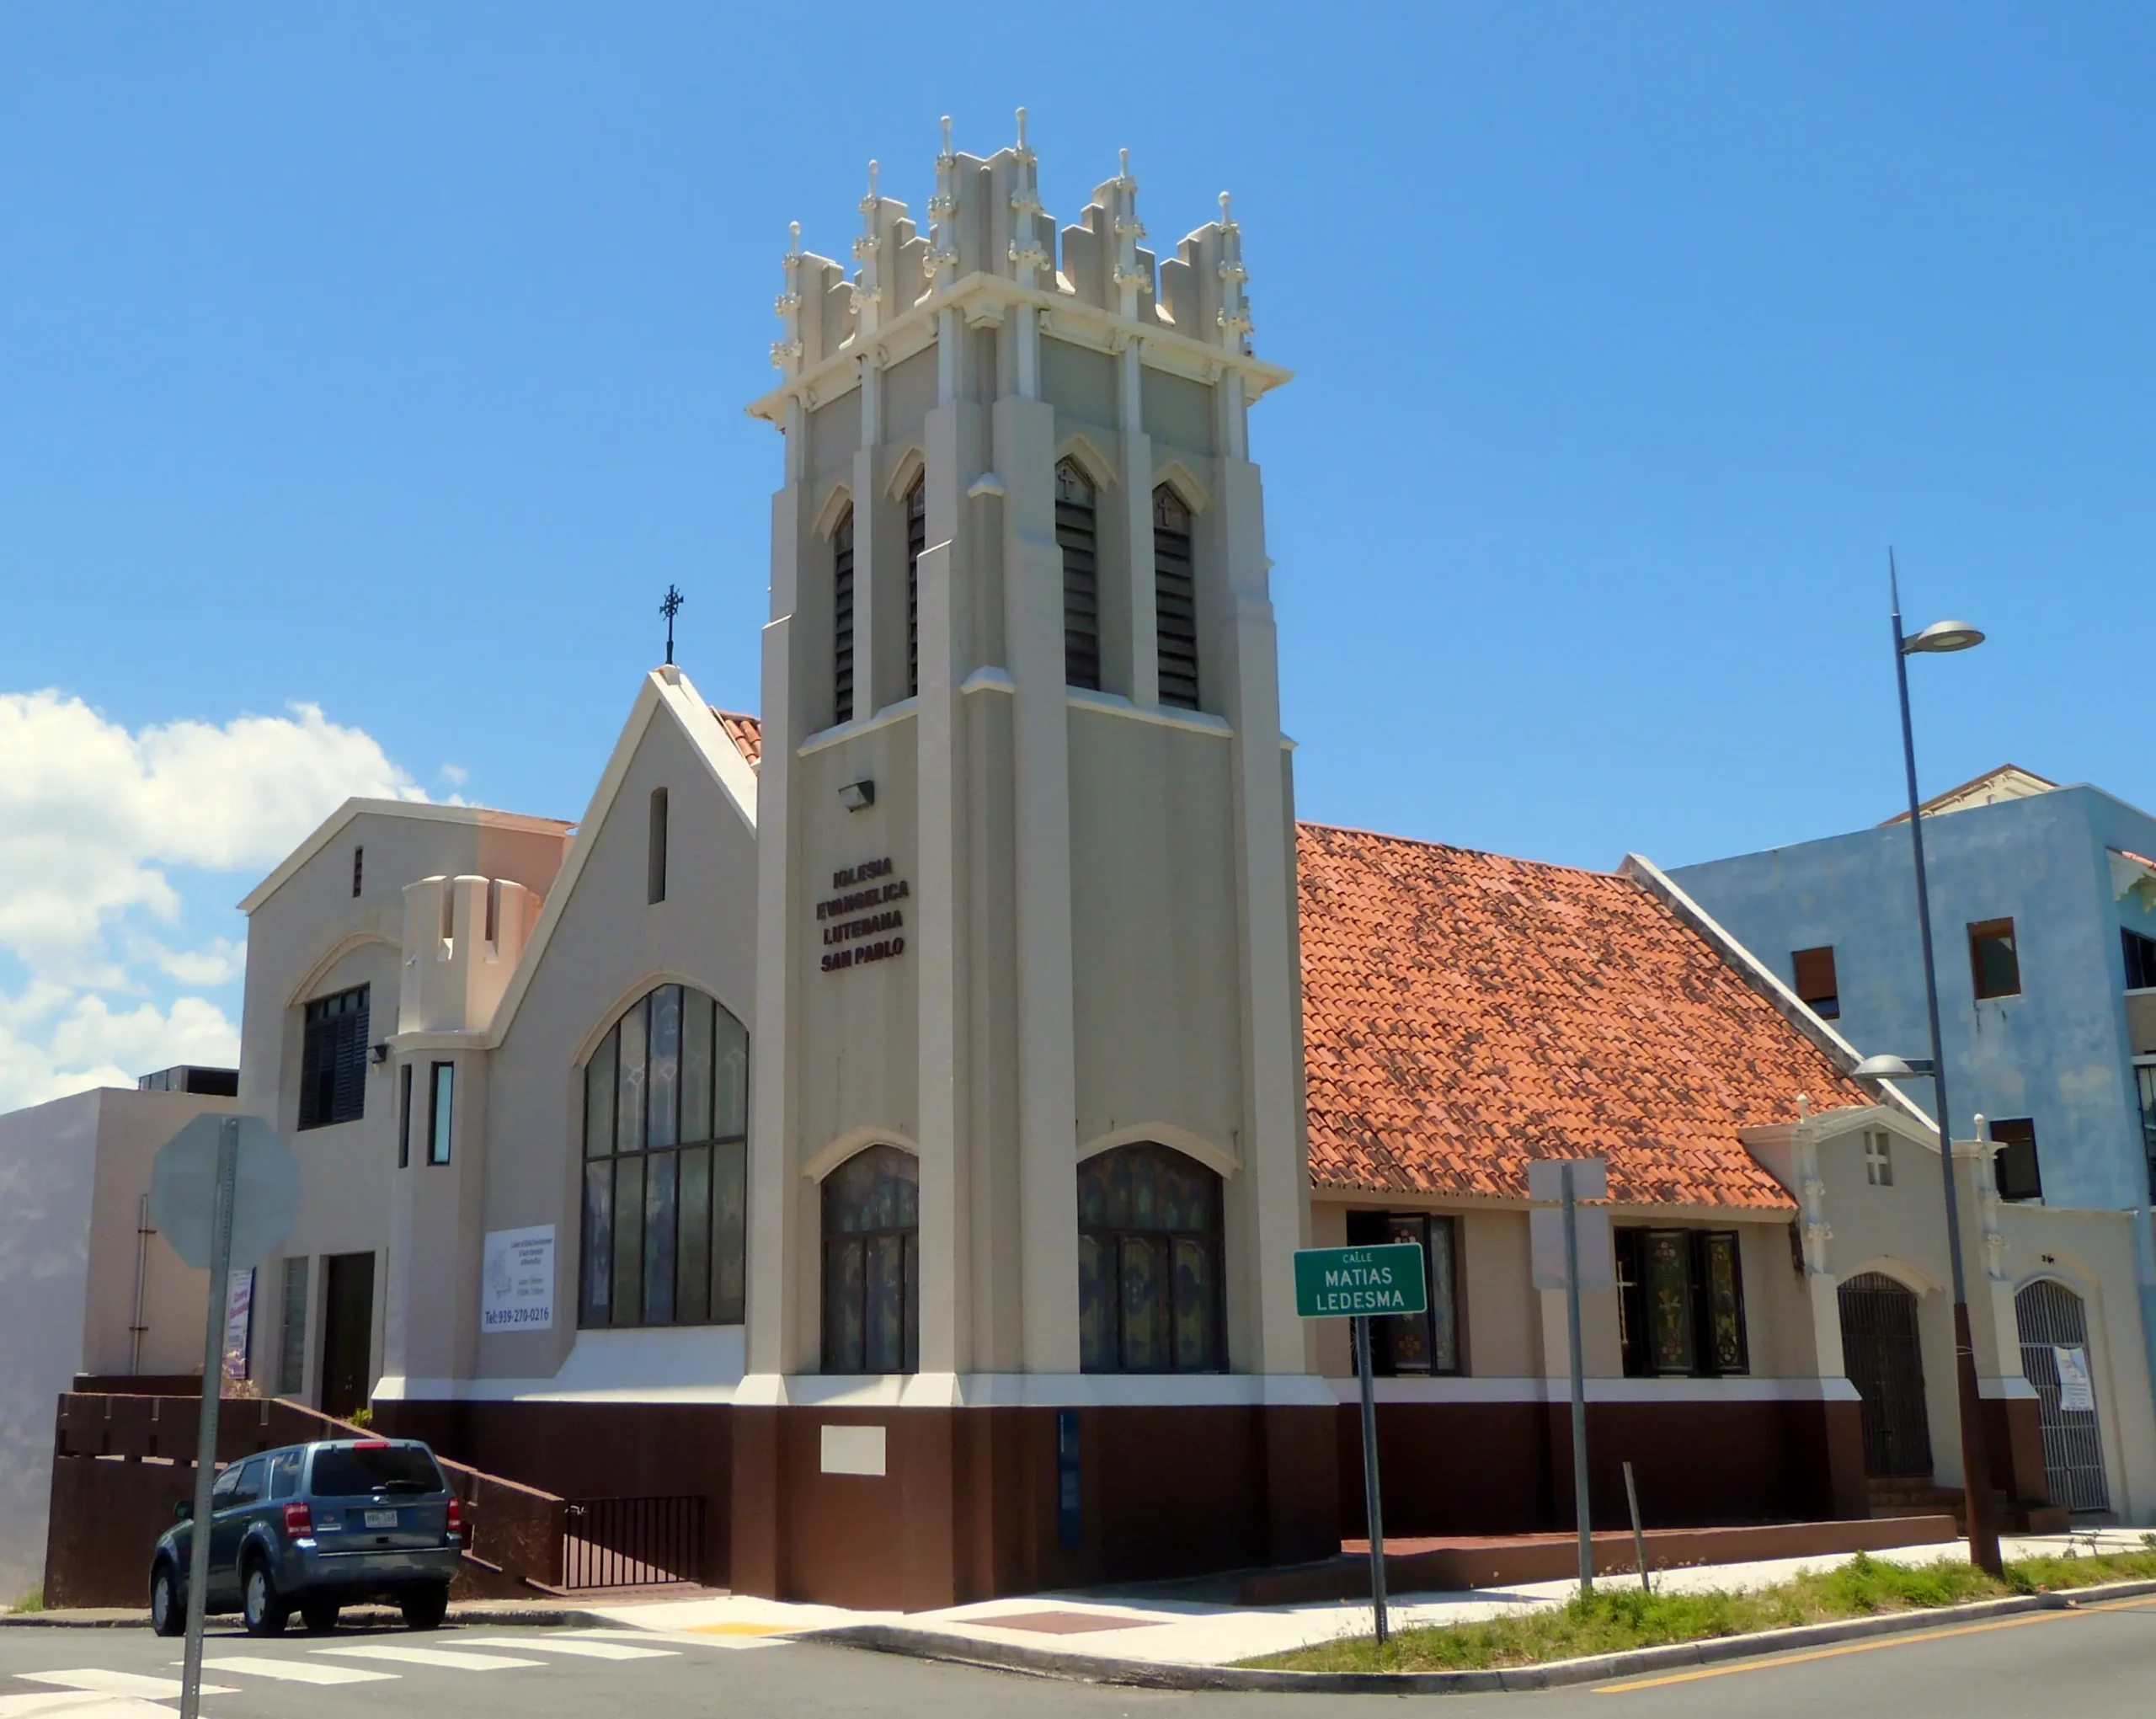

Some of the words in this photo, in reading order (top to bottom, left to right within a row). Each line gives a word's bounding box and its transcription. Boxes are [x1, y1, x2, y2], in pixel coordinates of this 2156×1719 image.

[833, 857, 893, 889] IGLESIA
[816, 880, 910, 921] EVANGELICA
[824, 910, 903, 945] LUTERANA
[821, 949, 851, 972] SAN
[855, 937, 905, 964] PABLO
[1342, 1252, 1372, 1263] CALLE
[1325, 1267, 1392, 1287] MATIAS
[1316, 1289, 1405, 1311] LEDESMA
